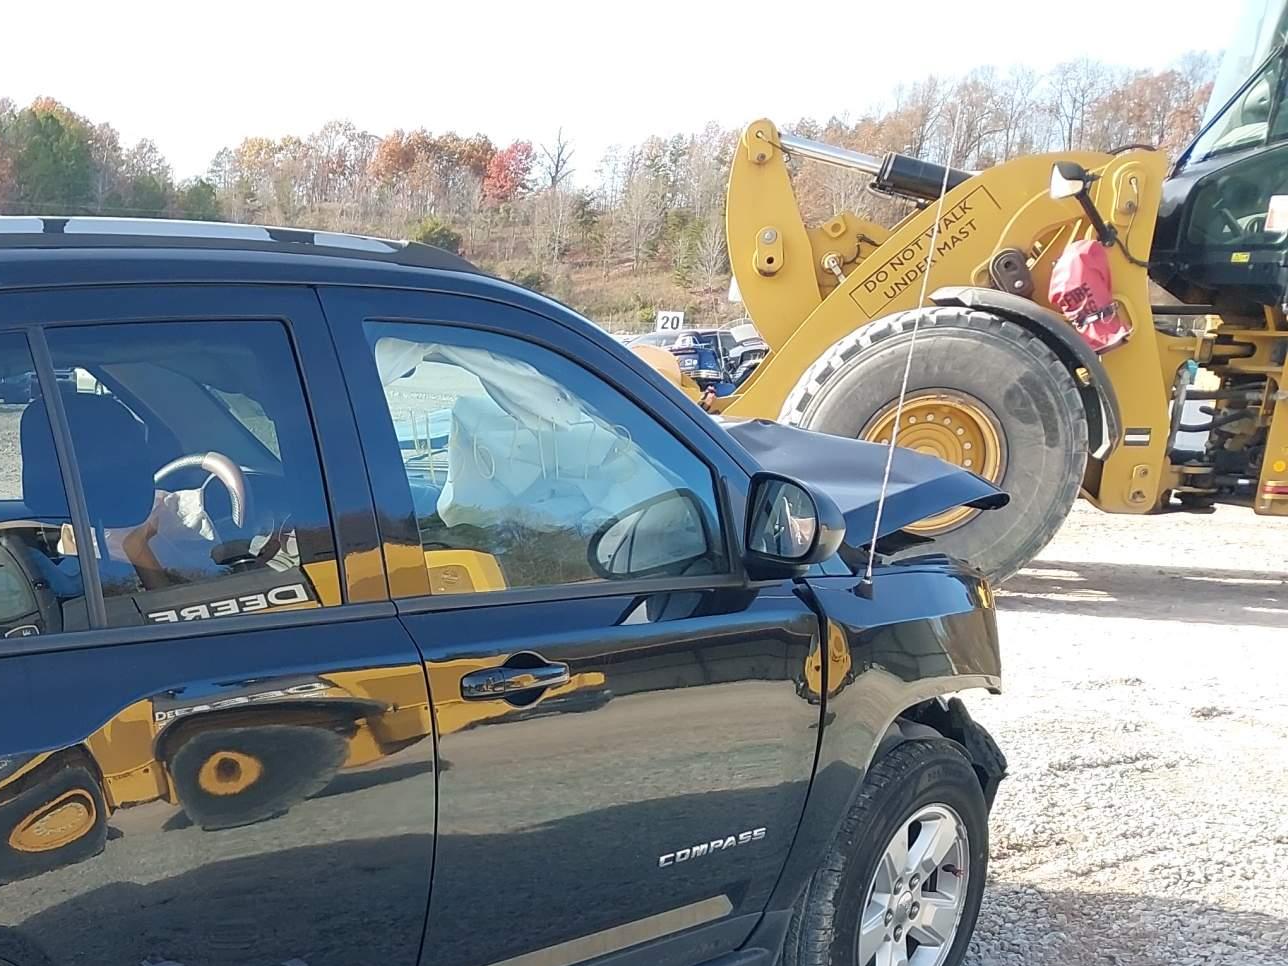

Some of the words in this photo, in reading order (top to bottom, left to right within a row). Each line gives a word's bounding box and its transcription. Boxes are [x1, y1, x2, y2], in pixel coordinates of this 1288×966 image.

[864, 270, 888, 293] DO
[890, 239, 924, 271] NOT
[925, 200, 973, 239] WALK
[884, 255, 936, 299] UNDER
[937, 218, 977, 256] MAST
[661, 315, 680, 330] 20
[658, 827, 767, 868] COMPASS
